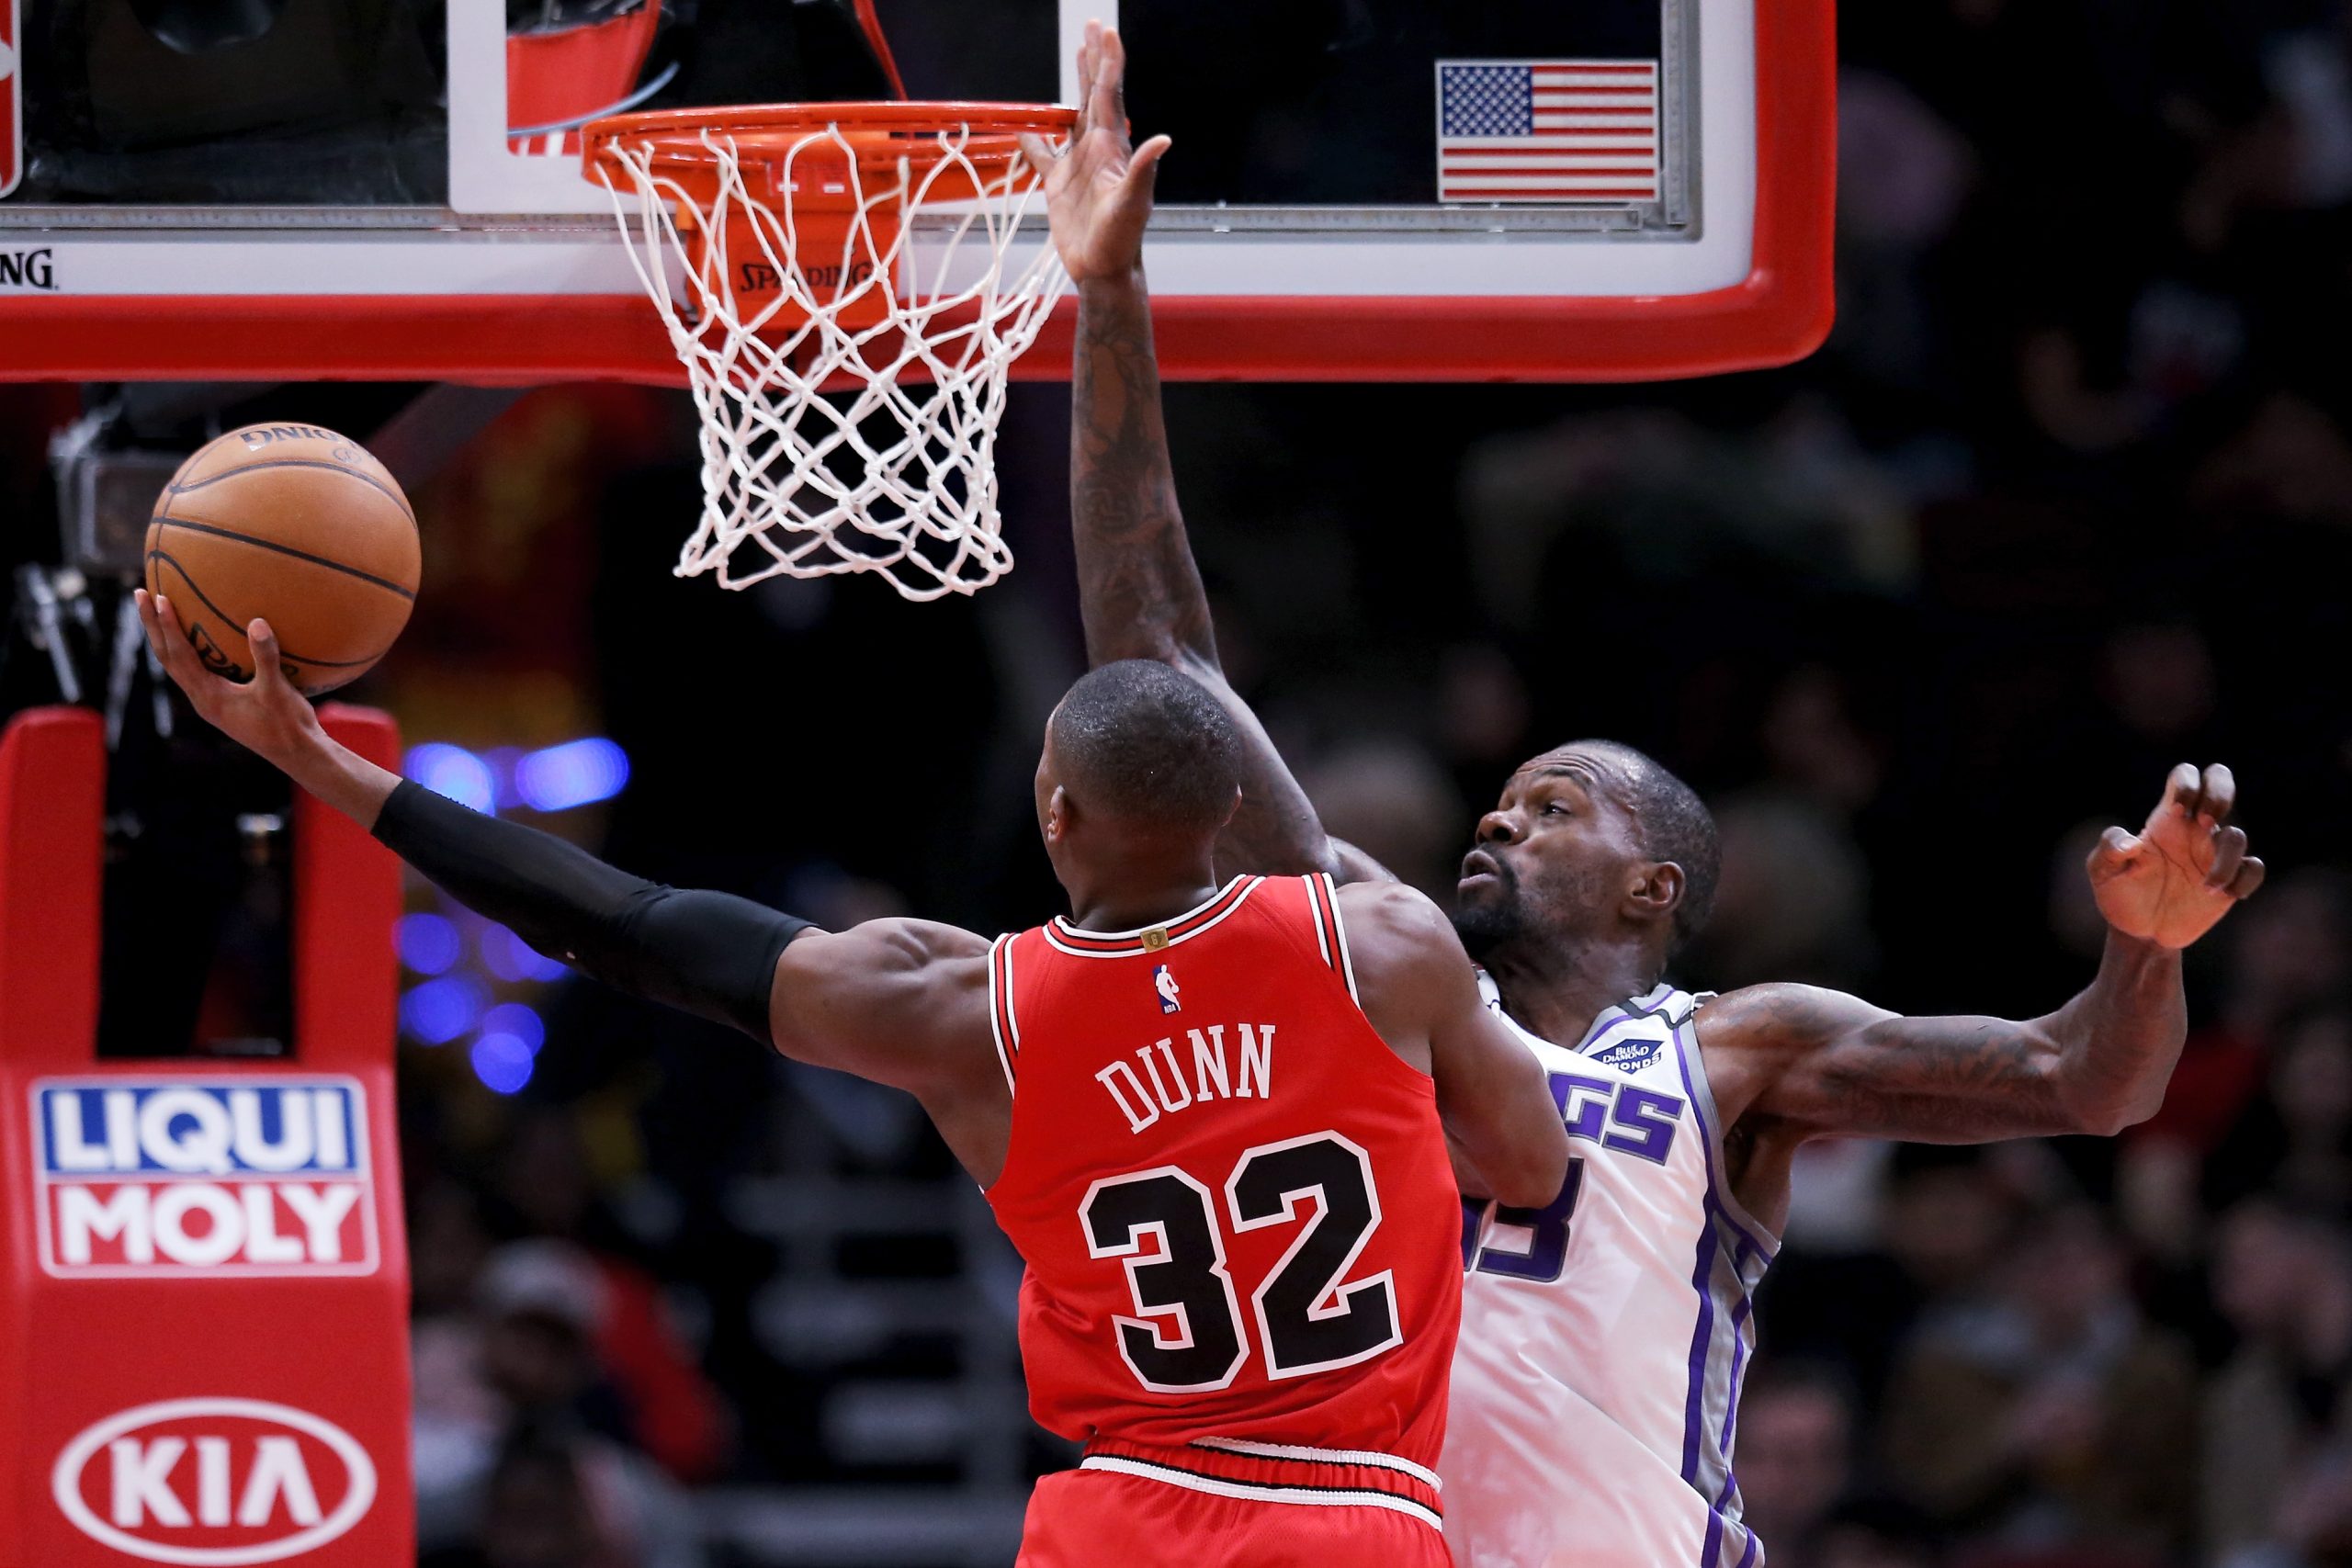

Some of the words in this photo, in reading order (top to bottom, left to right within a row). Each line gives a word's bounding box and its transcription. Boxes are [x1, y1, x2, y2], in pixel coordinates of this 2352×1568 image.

[1095, 1023, 1276, 1134] DUNN
[1602, 1046, 1649, 1064] DIAMOND
[1615, 1044, 1637, 1056] BLUE
[50, 1088, 348, 1175] LIQUI
[57, 1182, 361, 1266] MOLY
[1078, 1130, 1404, 1393] 32
[1461, 1157, 1585, 1282] 3
[109, 1436, 323, 1528] KIA
